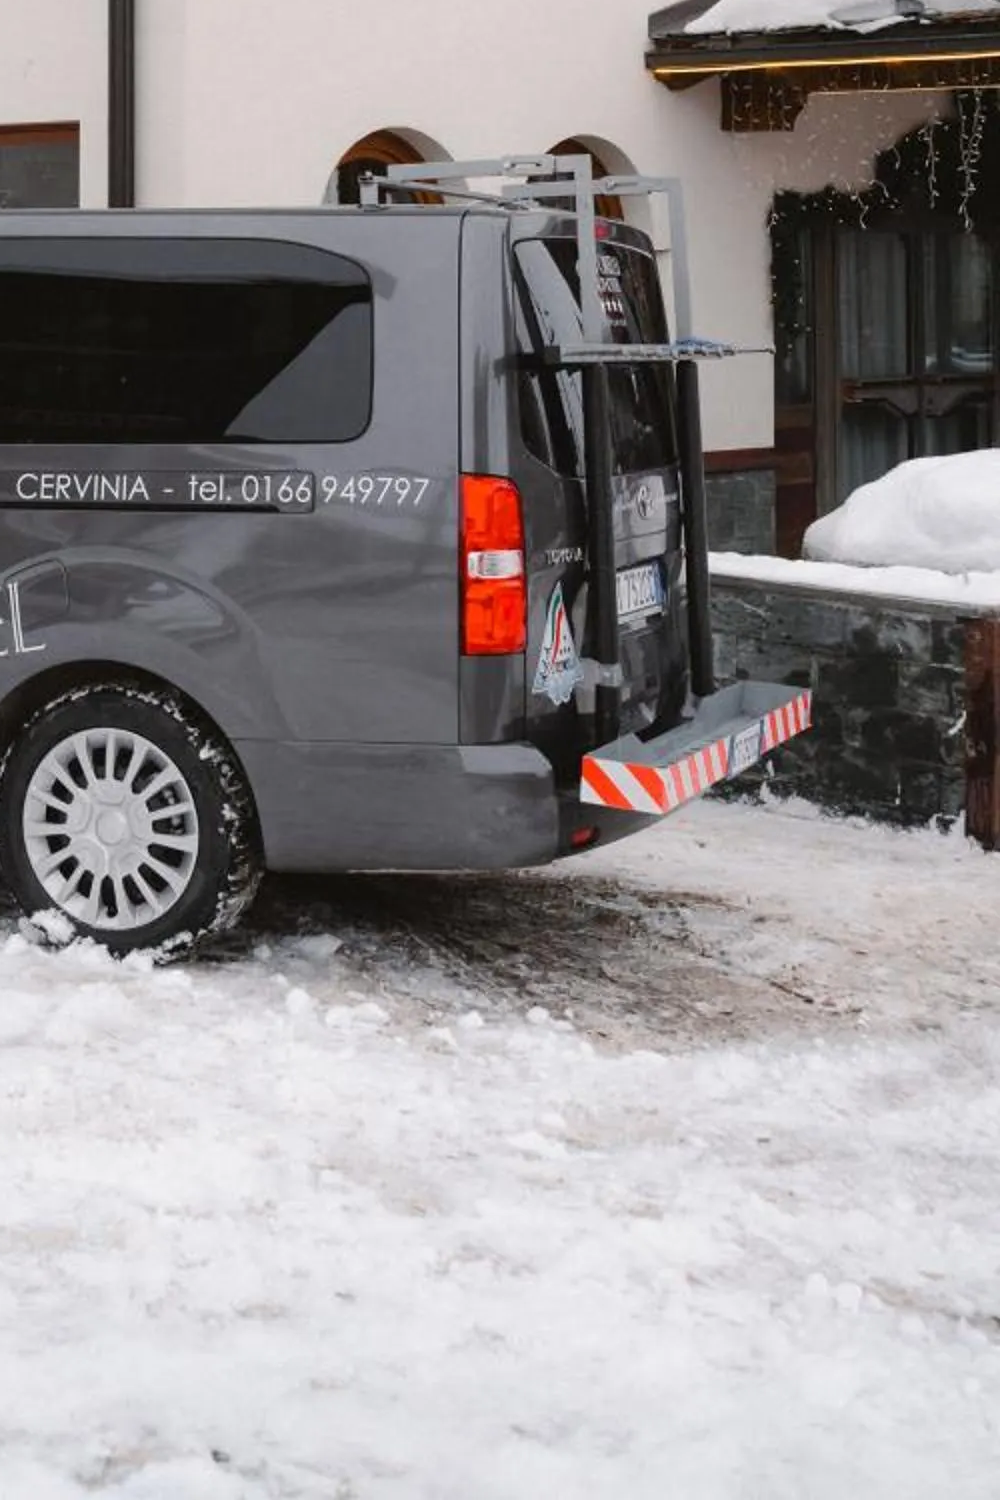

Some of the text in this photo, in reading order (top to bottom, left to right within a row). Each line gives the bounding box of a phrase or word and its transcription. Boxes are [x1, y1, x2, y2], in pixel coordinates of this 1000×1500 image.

[15, 472, 149, 501] CERVINIA
[187, 474, 231, 502] tel.
[241, 474, 311, 503] 0166
[321, 476, 430, 506] 949797
